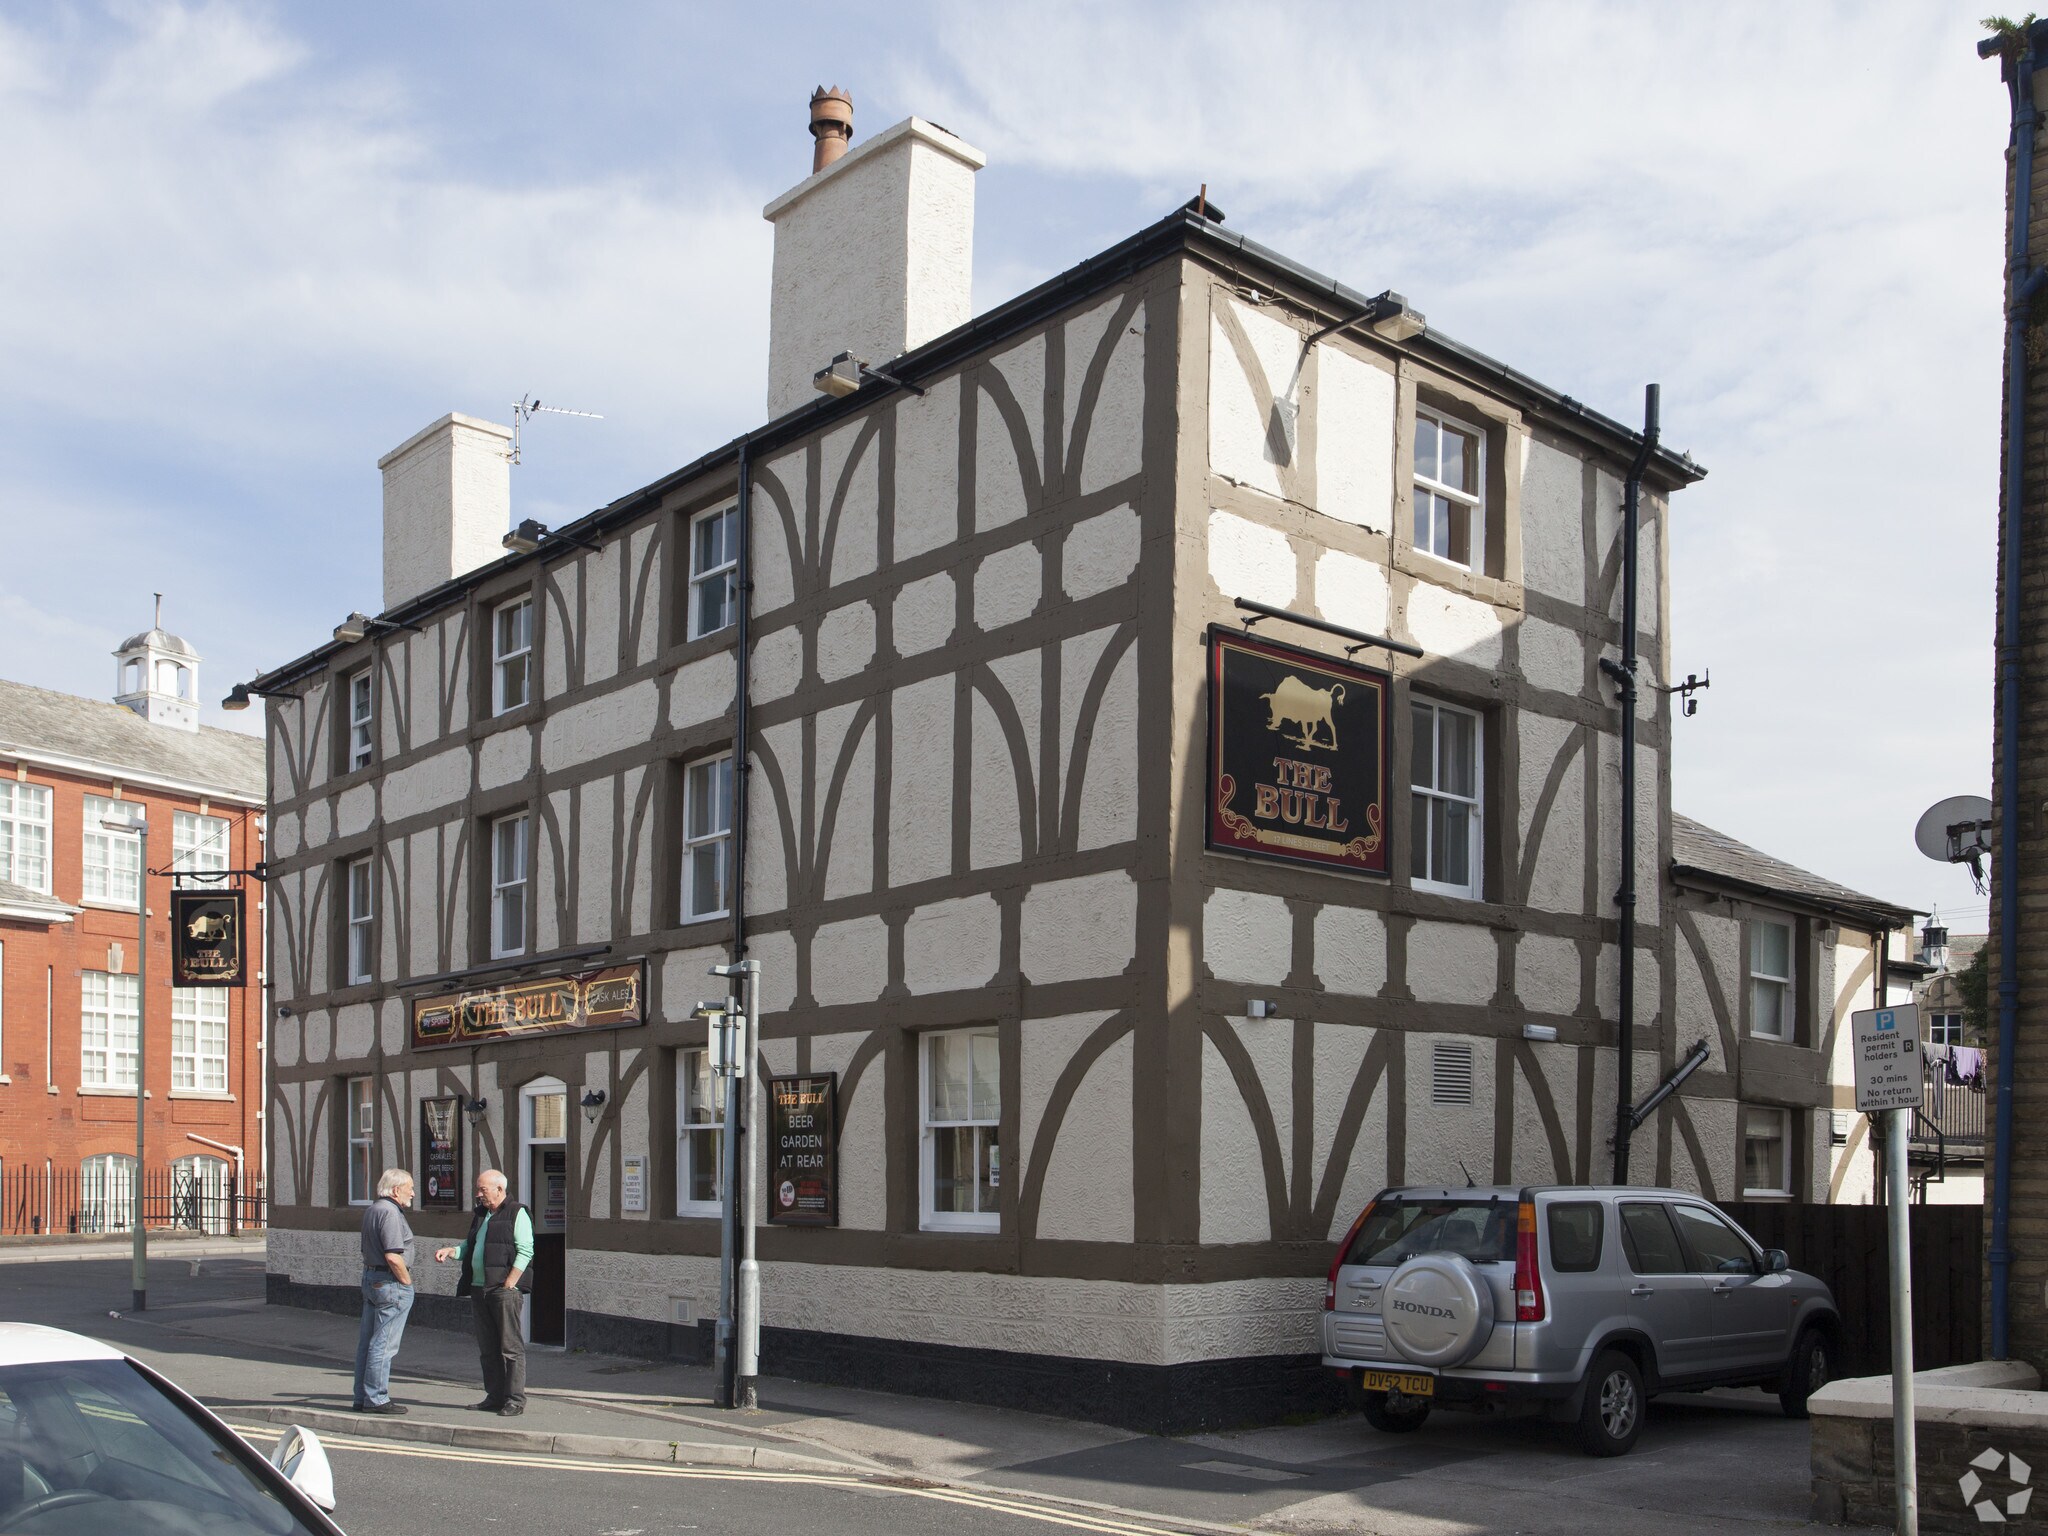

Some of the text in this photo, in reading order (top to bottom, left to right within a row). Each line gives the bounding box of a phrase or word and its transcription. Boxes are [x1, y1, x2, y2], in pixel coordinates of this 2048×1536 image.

[1273, 756, 1332, 794] THE
[1254, 782, 1349, 832] BULL
[1281, 836, 1304, 847] LINES
[1304, 839, 1331, 852] STREET
[197, 949, 221, 958] THE
[189, 957, 228, 968] BULL
[611, 988, 629, 1000] ALES
[474, 991, 563, 1028] THE BULL
[1880, 1013, 1892, 1029] P
[1860, 1031, 1900, 1043] Resident
[1866, 1042, 1896, 1053] permit
[1905, 1042, 1913, 1051] R
[1864, 1051, 1898, 1061] holders
[1870, 1074, 1908, 1085] 30 mins
[778, 1092, 825, 1105] THE BULL
[1867, 1087, 1912, 1097] No return
[1860, 1095, 1919, 1108] within 1 hour
[788, 1114, 814, 1128] BEER
[781, 1134, 822, 1148] GARDEN
[780, 1154, 824, 1168] AT REAR
[1392, 1299, 1457, 1320] HONDA
[1368, 1373, 1429, 1392] DV52 TCU
